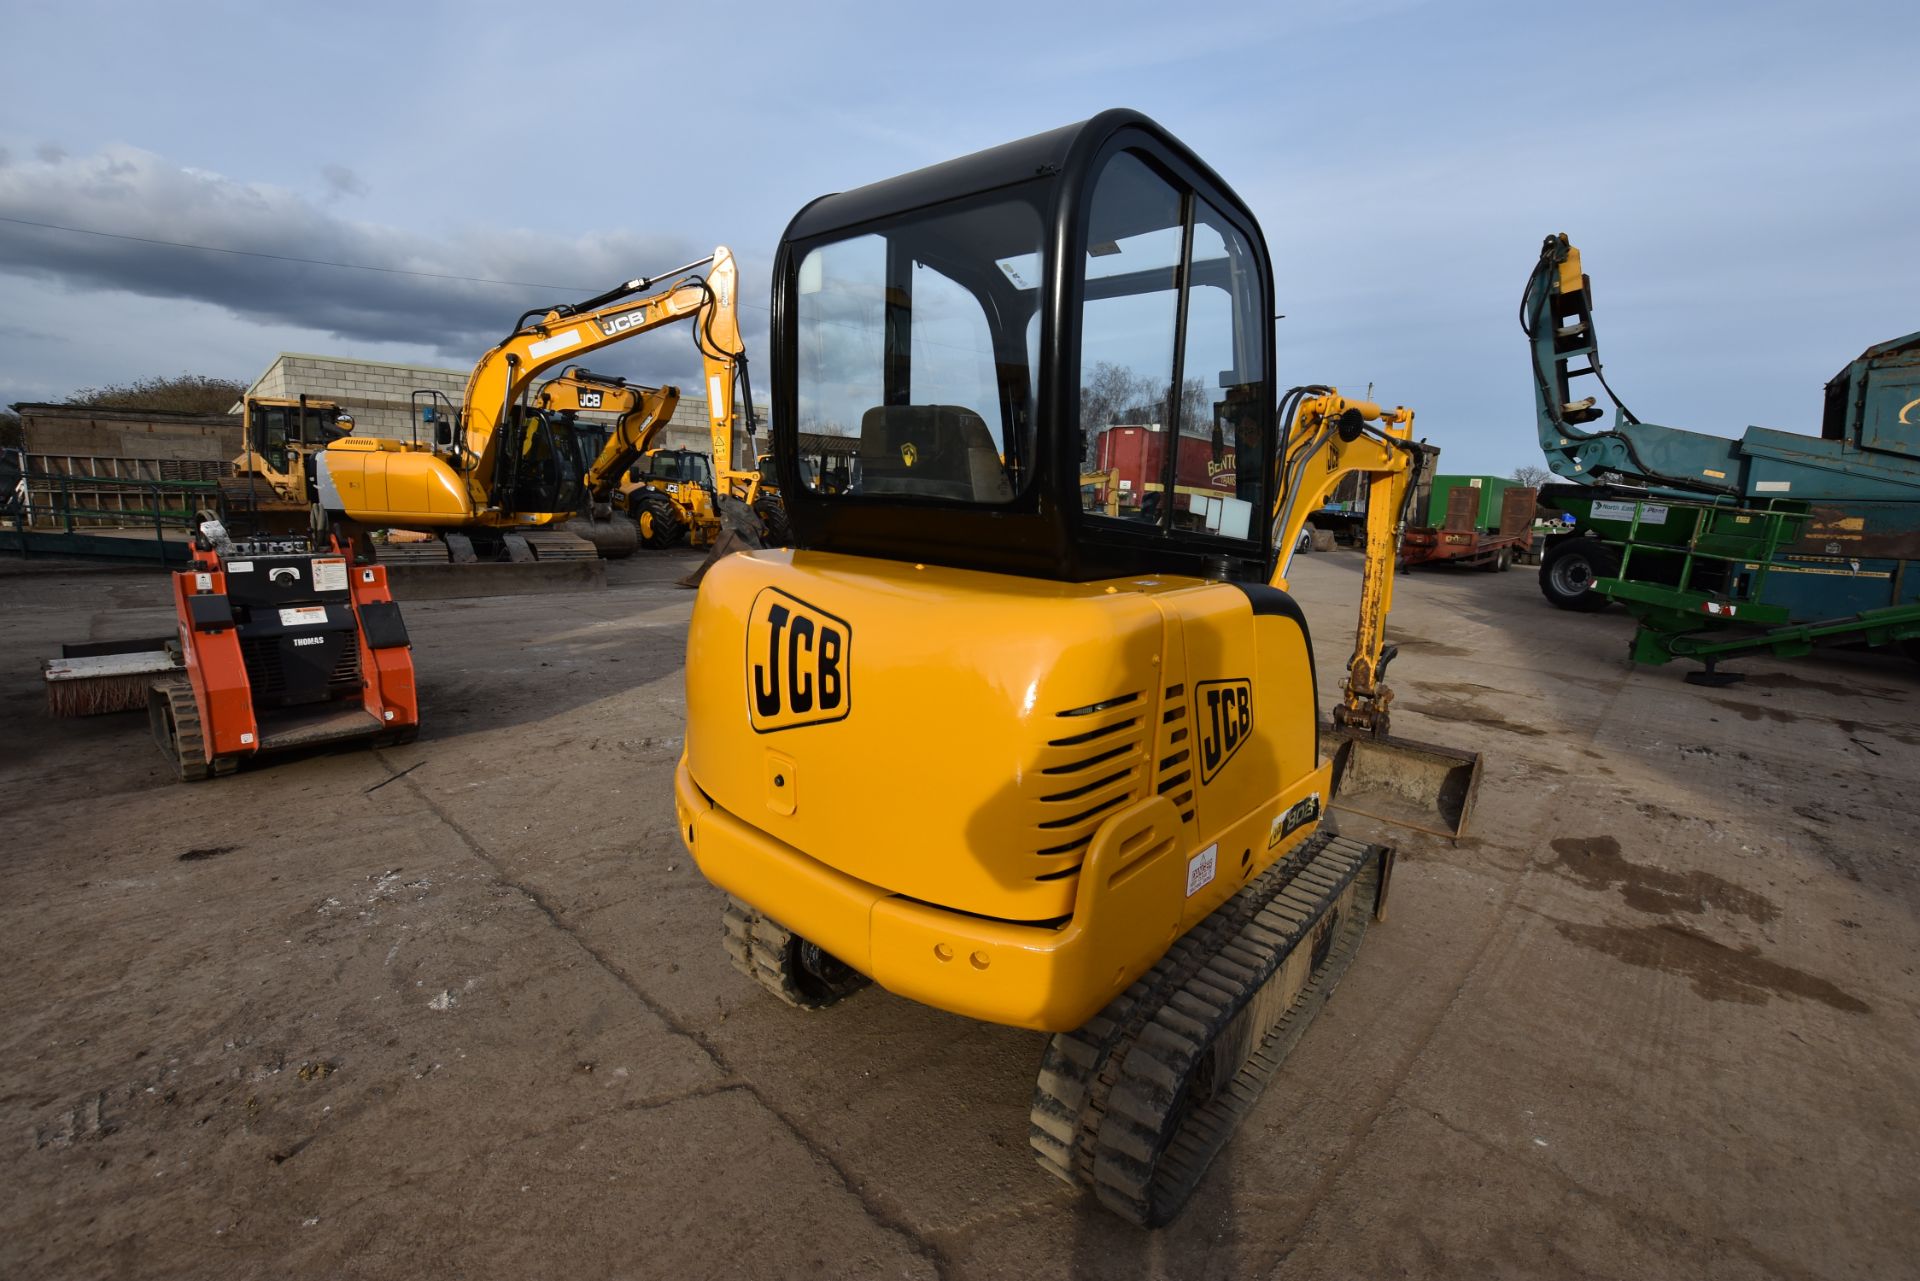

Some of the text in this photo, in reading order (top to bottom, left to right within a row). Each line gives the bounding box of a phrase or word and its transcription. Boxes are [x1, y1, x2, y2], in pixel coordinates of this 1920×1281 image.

[604, 311, 645, 336] JCB
[579, 393, 601, 407] JCB
[1327, 444, 1339, 471] JCB
[665, 484, 679, 493] JCB
[1602, 503, 1620, 511] North
[293, 636, 325, 647] THOMAS
[754, 603, 842, 718] JCB
[1203, 685, 1252, 771] JCB
